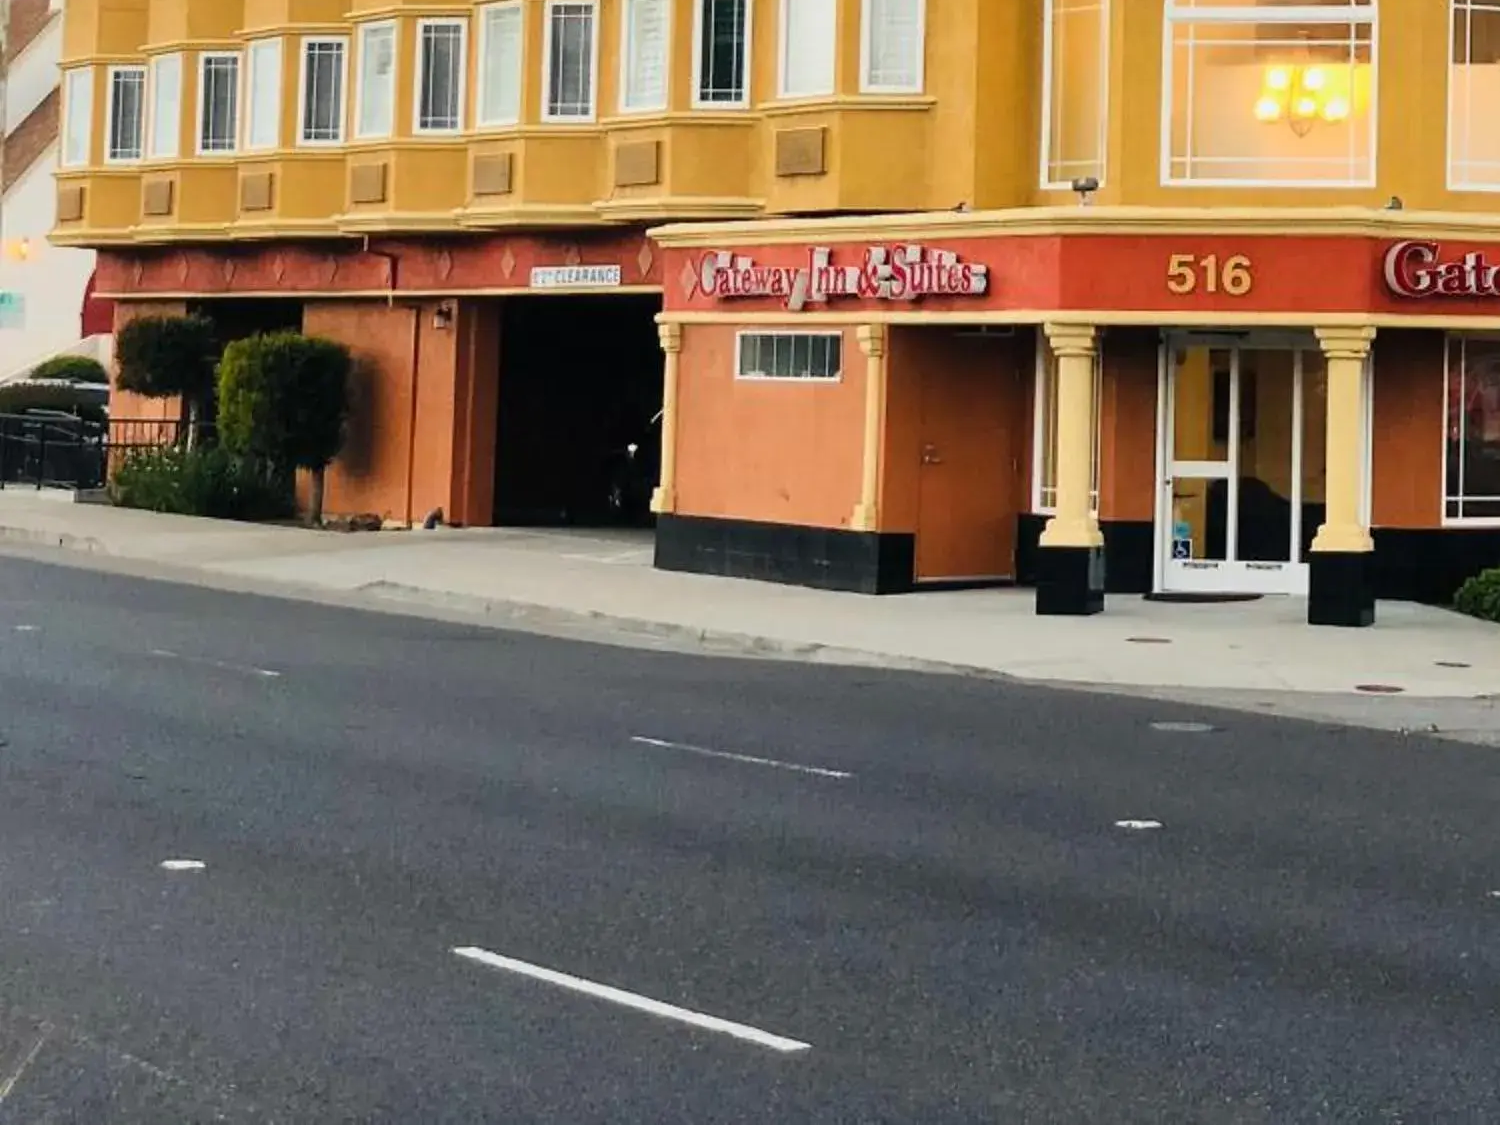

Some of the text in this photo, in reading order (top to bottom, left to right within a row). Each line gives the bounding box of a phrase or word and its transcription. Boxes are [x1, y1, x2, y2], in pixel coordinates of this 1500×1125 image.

[700, 243, 976, 311] Gateway Inn & Suites
[1167, 254, 1252, 296] 516
